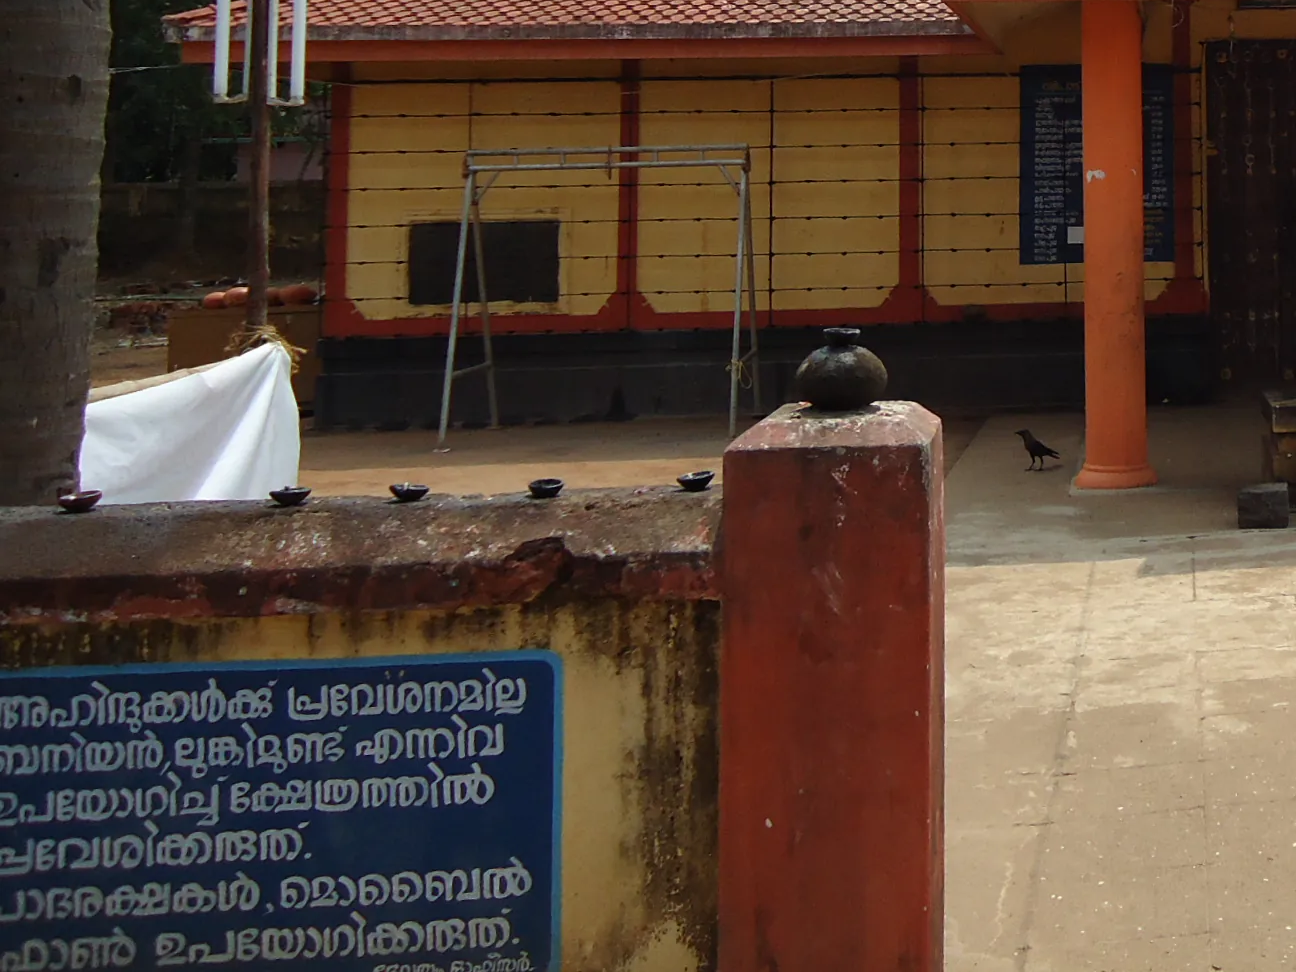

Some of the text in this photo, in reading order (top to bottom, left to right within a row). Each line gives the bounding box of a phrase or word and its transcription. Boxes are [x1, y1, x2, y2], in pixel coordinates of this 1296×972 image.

[287, 668, 527, 721] പ്രവേശനമില്ല
[356, 714, 505, 764] എന്നിവ
[230, 762, 495, 813] ക്ഷേത്രത്തിൽ
[280, 856, 533, 909] മൊബൈൽ
[155, 908, 520, 966] ഉപയോഗിക്കരുത്.
